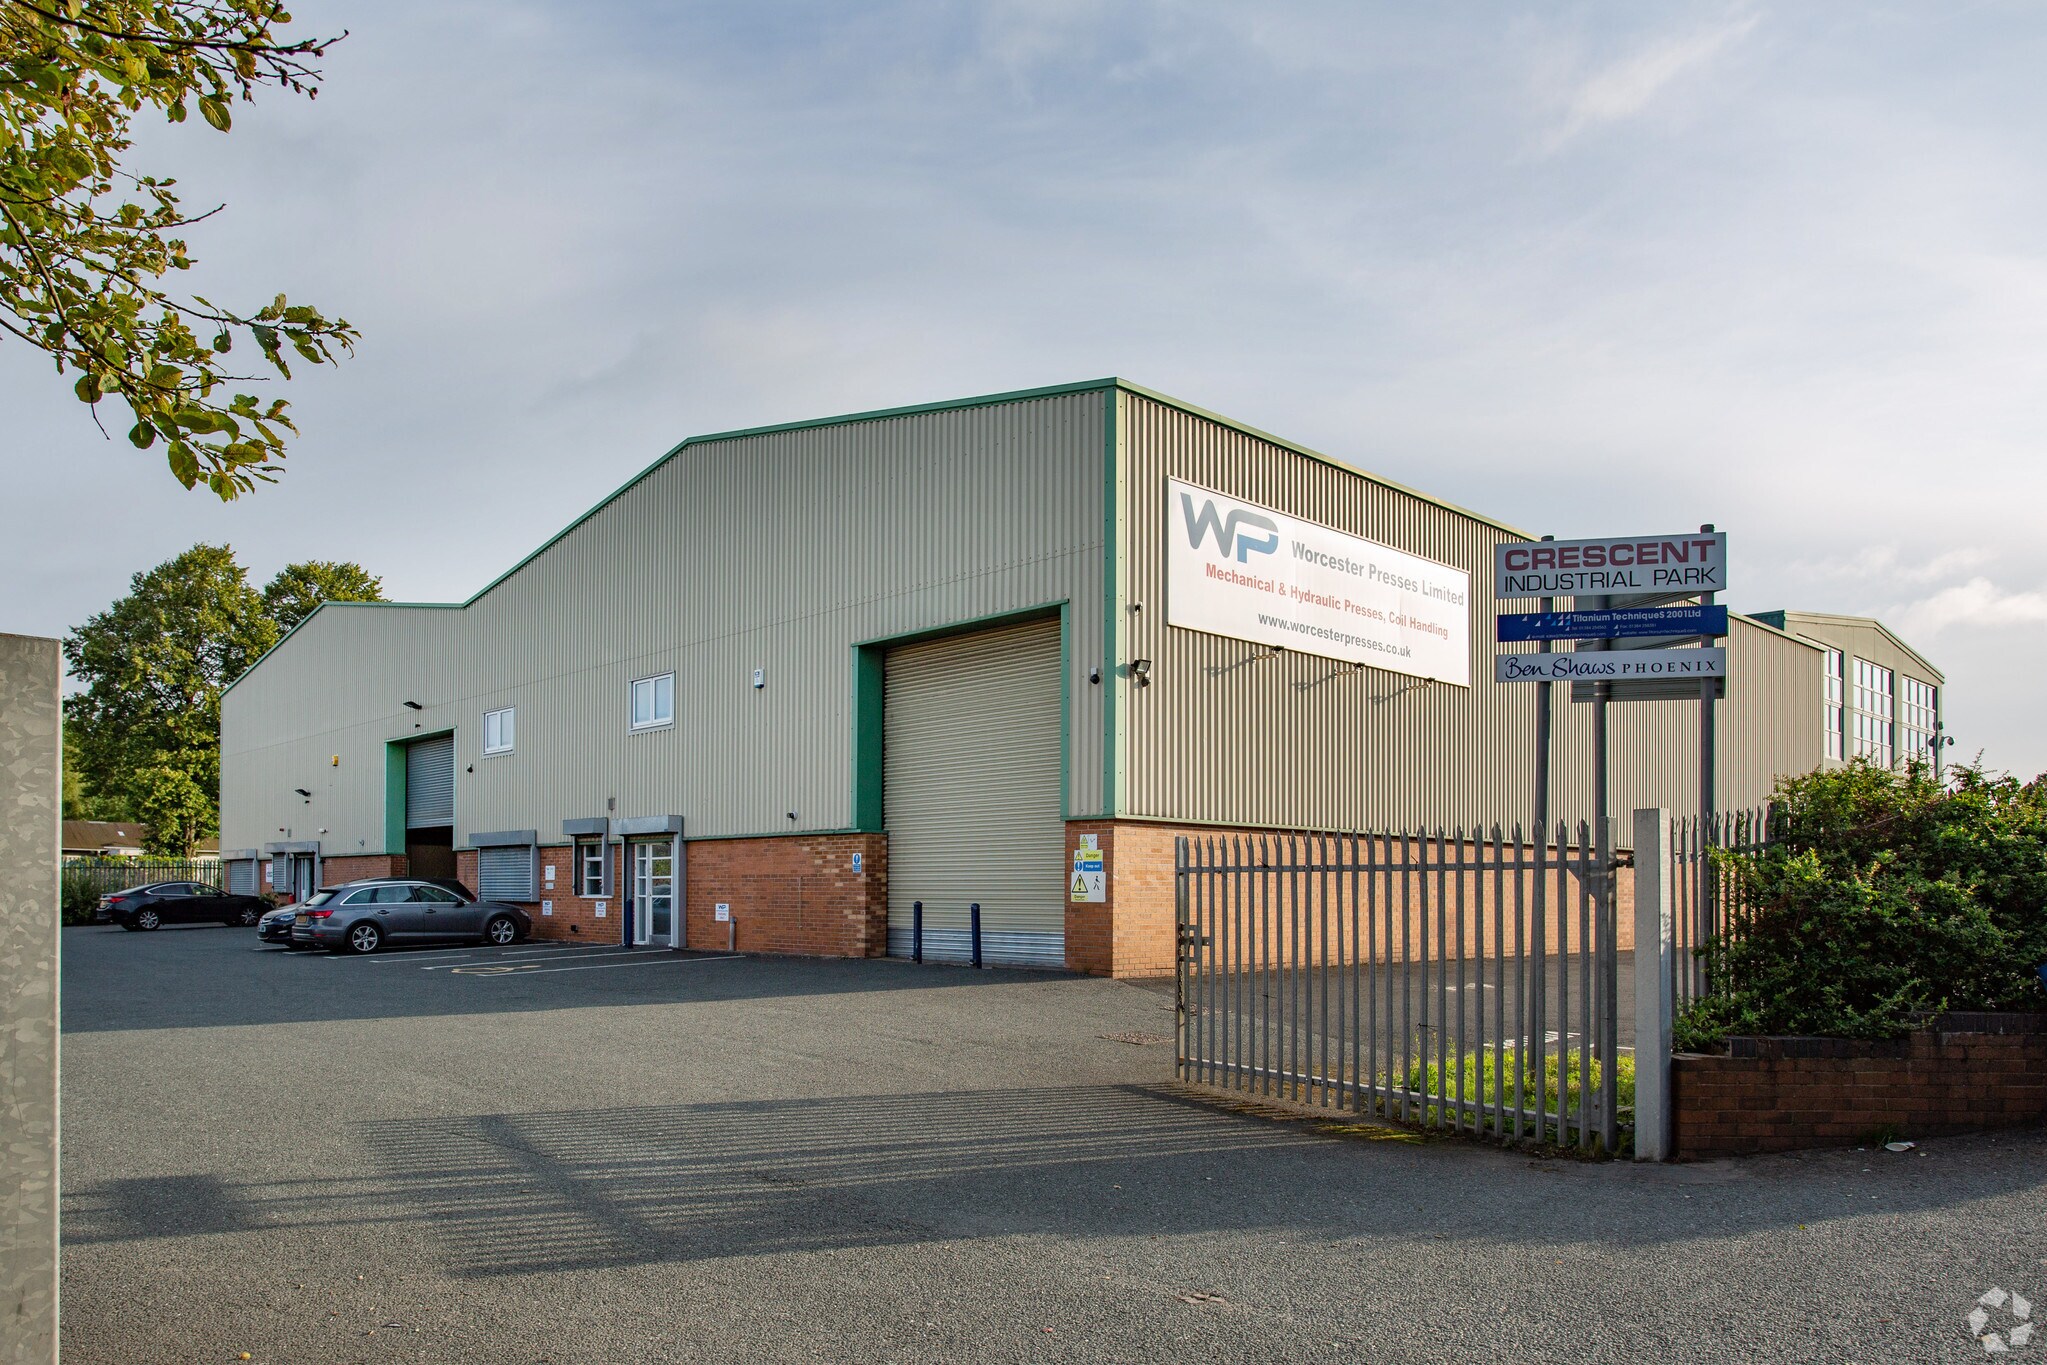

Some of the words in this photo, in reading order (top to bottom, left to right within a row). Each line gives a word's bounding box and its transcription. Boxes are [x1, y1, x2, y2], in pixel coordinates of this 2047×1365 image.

[1504, 539, 1716, 571] CRESCENT
[1291, 540, 1365, 577] Worcester
[1368, 563, 1418, 592] Presses
[1422, 579, 1464, 606] Limited
[1504, 570, 1642, 593] INDUSTRIAL
[1653, 566, 1716, 586] PARK
[1206, 562, 1274, 593] Mechanical
[1278, 582, 1287, 596] &
[1290, 585, 1341, 610] Hydraulic
[1344, 599, 1386, 624] Presses,
[1388, 611, 1407, 627] Coil
[1409, 617, 1449, 640] Handling
[1572, 613, 1610, 622] Titanium
[1258, 613, 1411, 658] www.worcesterpresses.co.uk
[1505, 656, 1550, 679] Ben
[1552, 657, 1616, 678] Shaws
[1622, 660, 1716, 674] PHOENIX
